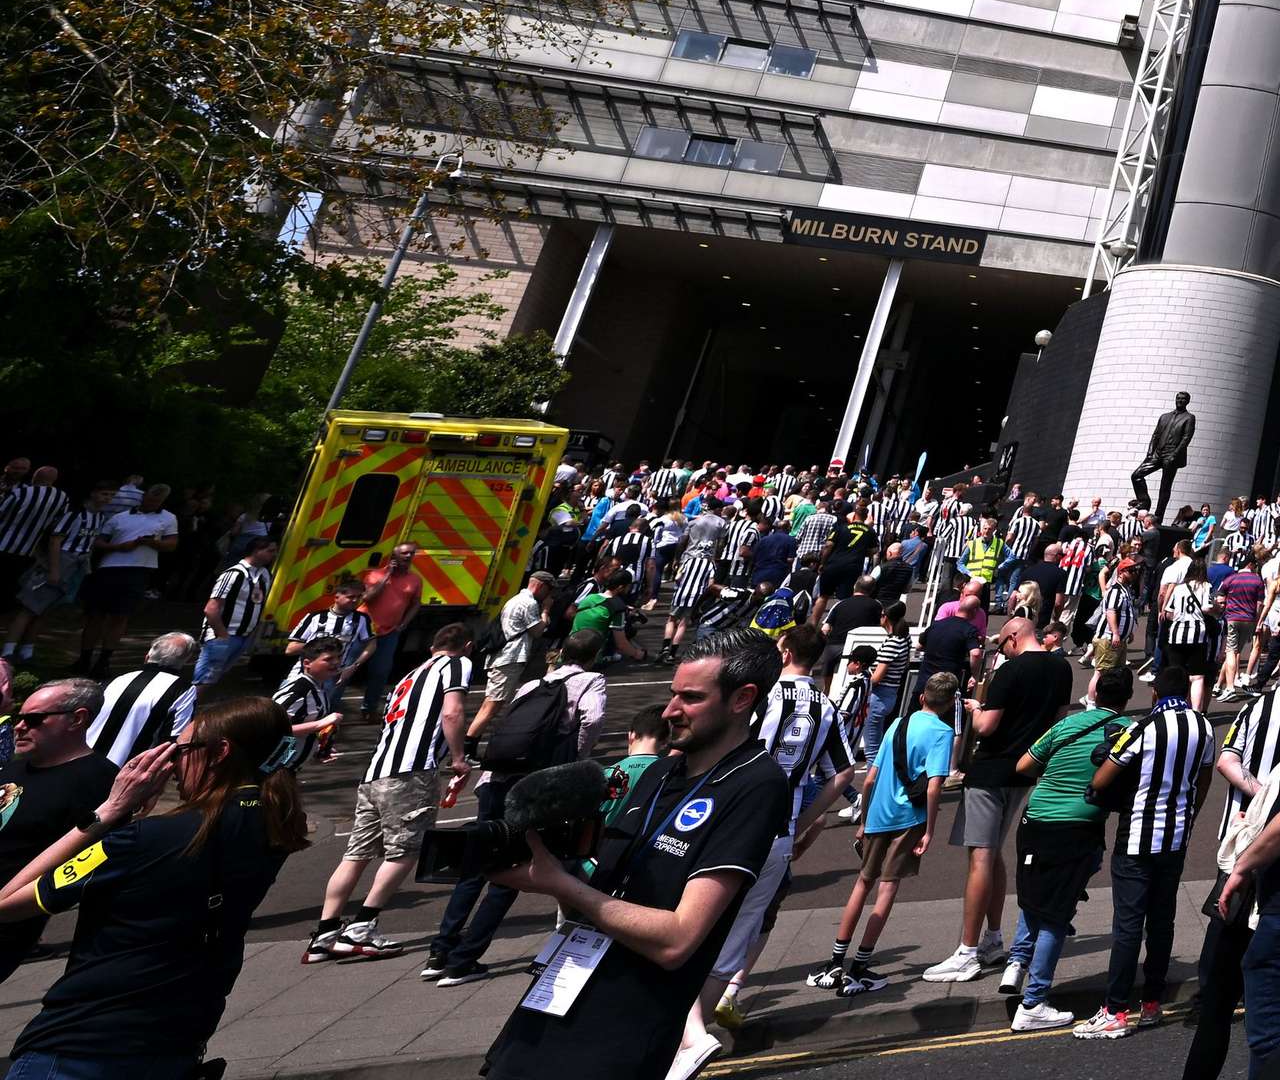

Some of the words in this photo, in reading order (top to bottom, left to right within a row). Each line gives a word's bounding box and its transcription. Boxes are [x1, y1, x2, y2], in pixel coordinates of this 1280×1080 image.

[791, 218, 899, 246] MILBURN
[903, 232, 979, 255] STAND
[434, 458, 522, 475] AMBULANCE
[847, 529, 864, 548] 7
[1180, 595, 1196, 614] 18
[774, 687, 829, 705] SHEARER
[773, 712, 816, 770] 9
[653, 840, 686, 857] EXPRESS
